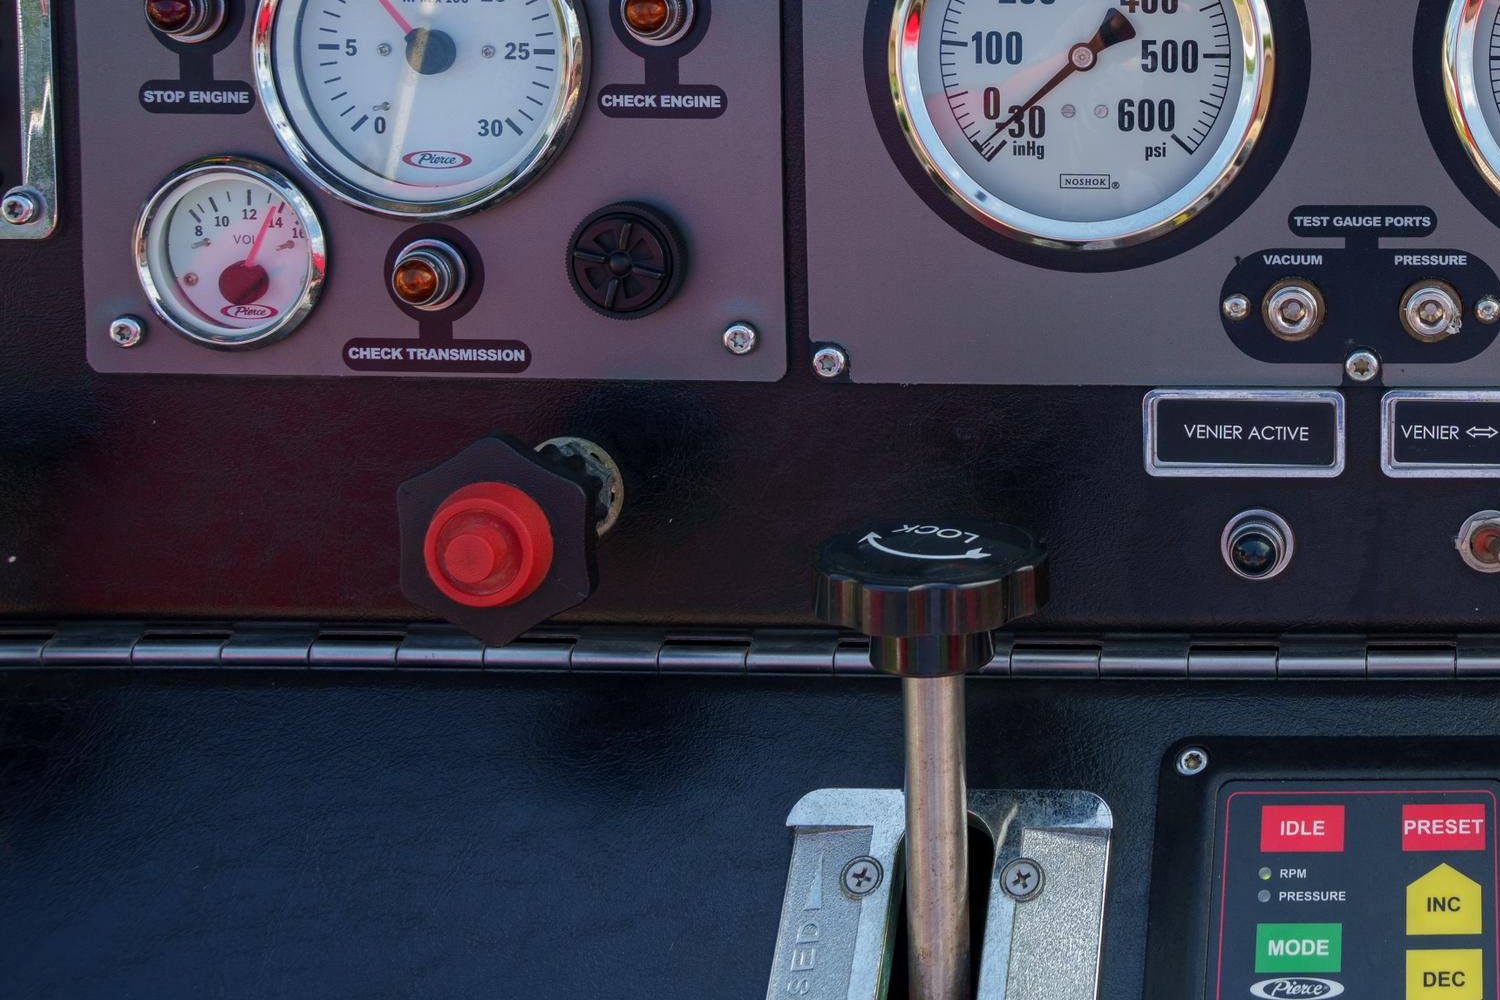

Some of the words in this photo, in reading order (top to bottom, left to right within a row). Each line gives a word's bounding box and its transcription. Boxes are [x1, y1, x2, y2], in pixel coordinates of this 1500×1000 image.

[345, 38, 357, 56] 5
[504, 42, 530, 60] 25
[971, 31, 1023, 65] 100
[1141, 39, 1199, 73] 500
[143, 90, 186, 104] STOP
[189, 90, 249, 104] ENGINE
[601, 94, 656, 108] CHECK
[660, 94, 721, 109] ENGINE
[983, 87, 1000, 120] 0
[1117, 99, 1176, 133] 600
[374, 116, 386, 134] 0
[477, 118, 503, 136] 30
[1012, 141, 1045, 160] inHg
[1145, 142, 1167, 161] psi
[418, 153, 457, 165] Pierce
[1065, 178, 1106, 186] NOSHOK
[195, 225, 203, 236] 8
[215, 216, 229, 227] 10
[242, 209, 257, 220] 12
[268, 217, 283, 228] 14
[1294, 216, 1329, 227] TEST
[1333, 216, 1381, 228] GAUGE
[1385, 216, 1431, 228] PORTS
[1263, 255, 1323, 266] VACUUM
[1394, 255, 1467, 266] PRESSURE
[234, 304, 267, 317] Pierce
[348, 347, 403, 361] CHECK
[406, 347, 526, 362] TRANSMISSION
[1184, 424, 1243, 440] VENIER
[1248, 425, 1309, 441] ACTIVE
[1401, 424, 1460, 440] VENIER
[891, 524, 980, 543] LOCK
[1280, 820, 1325, 836] IDLE
[1403, 819, 1484, 835] PRESET
[1279, 868, 1307, 879] RPM
[1279, 890, 1346, 902] PRESSURE
[1426, 897, 1461, 912] INC
[1268, 939, 1330, 956] MODE
[1423, 971, 1465, 987] DEC
[1271, 980, 1323, 996] Pierce
